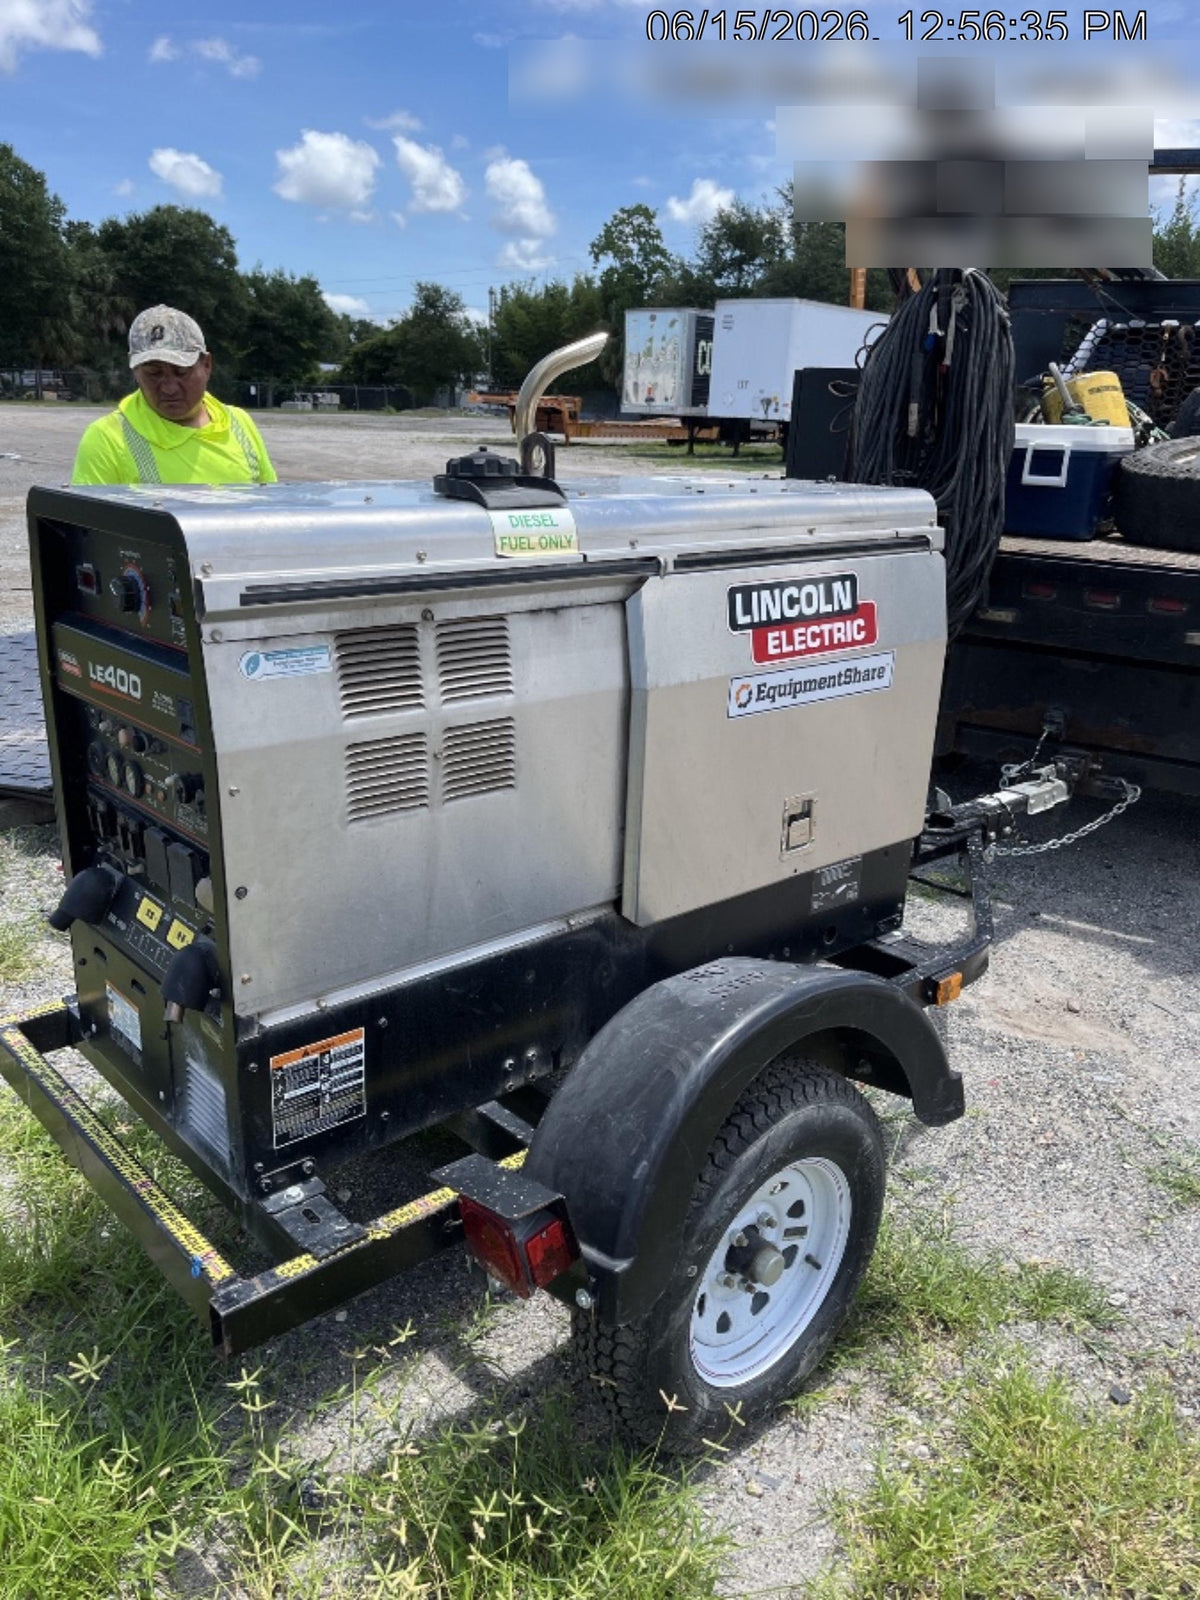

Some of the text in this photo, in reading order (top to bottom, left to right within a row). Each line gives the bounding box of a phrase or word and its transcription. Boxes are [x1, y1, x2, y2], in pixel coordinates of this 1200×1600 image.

[508, 513, 559, 529] DIESEL
[500, 534, 573, 551] FUEL ONLY
[735, 580, 852, 625] LINCOLN
[767, 618, 866, 655] ELECTRIC
[88, 661, 142, 700] LE400
[755, 665, 886, 703] EquipmentShare
